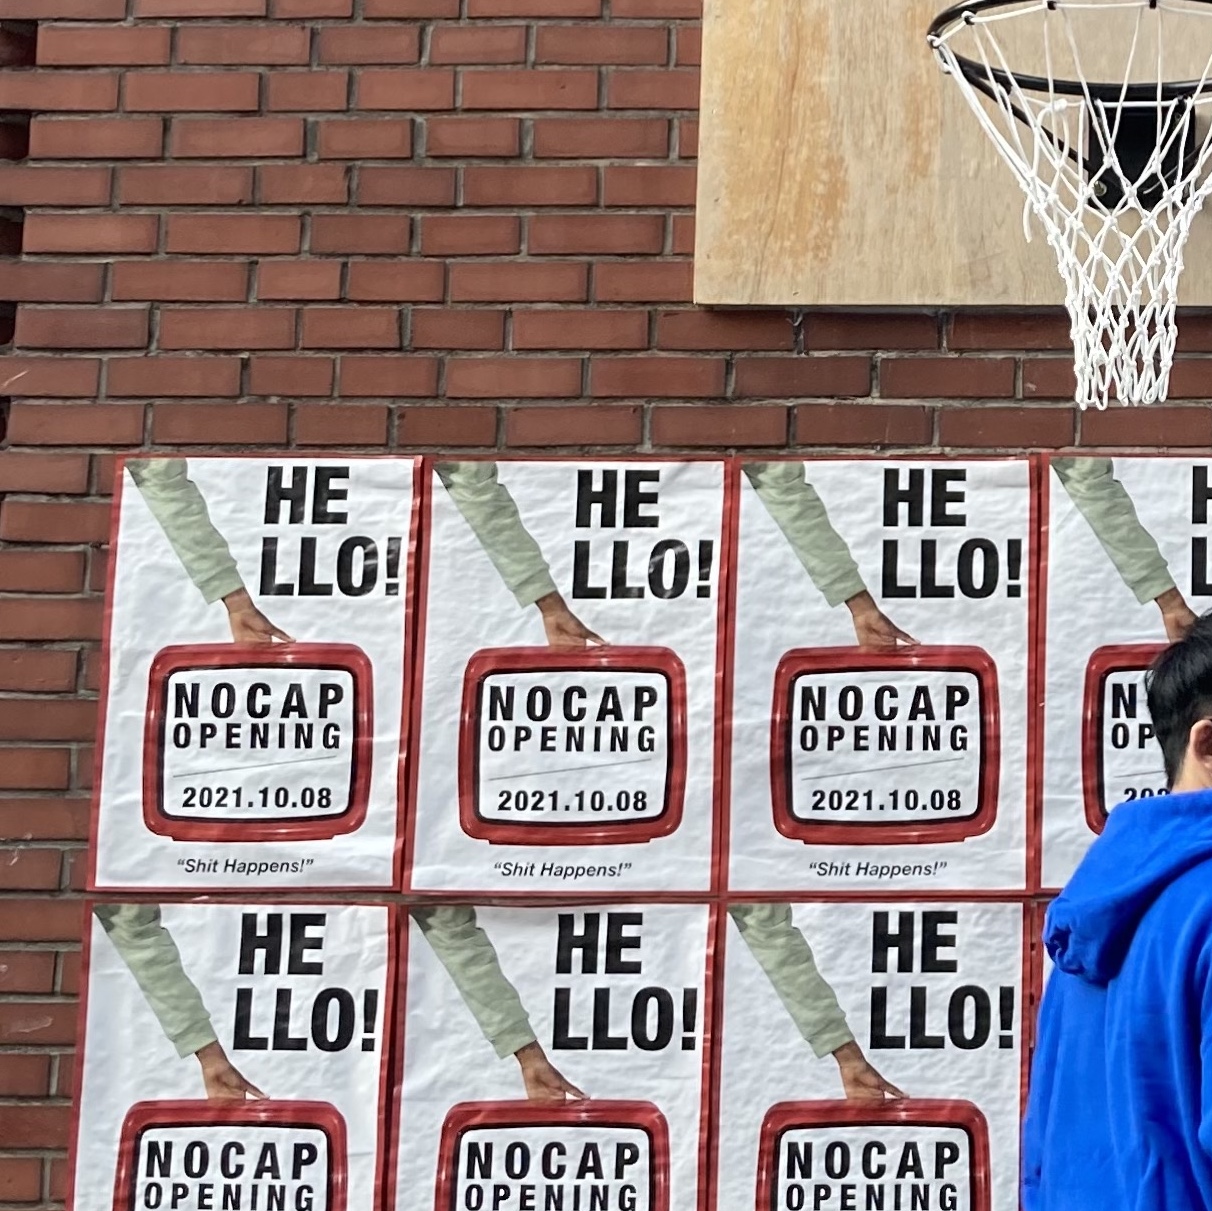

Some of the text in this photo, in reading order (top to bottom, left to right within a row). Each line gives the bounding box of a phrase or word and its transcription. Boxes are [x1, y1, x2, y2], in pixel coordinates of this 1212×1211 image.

[264, 466, 349, 524] HE
[576, 470, 659, 528] HE
[883, 468, 966, 526] HE
[259, 536, 401, 596] LLO!
[572, 539, 713, 599] LLO!
[882, 538, 1021, 598] LLO!
[175, 683, 343, 718] NOCAP
[489, 686, 657, 721] NOCAP
[801, 686, 969, 721] NOCAP
[173, 723, 340, 749] OPENING
[489, 726, 654, 752] OPENING
[800, 725, 967, 751] OPENING
[182, 787, 331, 808] 2021.10.08
[498, 791, 646, 811] 2021.10.08
[812, 790, 960, 810] 2021.10.08
[178, 859, 313, 875] “Shit Happens!”
[495, 863, 631, 879] “Shit Happens!”
[810, 862, 947, 878] “Shit Happens!”
[238, 913, 326, 975] HE
[556, 913, 643, 974] HE
[872, 911, 957, 973] HE
[233, 988, 378, 1052] LLO!
[552, 987, 697, 1051] LLO!
[870, 985, 1014, 1049] LLO!
[146, 1141, 317, 1179] NOCAP
[467, 1142, 639, 1179] NOCAP
[787, 1141, 959, 1179] NOCAP
[145, 1182, 313, 1211] OPENING
[465, 1184, 636, 1211] OPENING
[786, 1184, 957, 1211] OPENING
